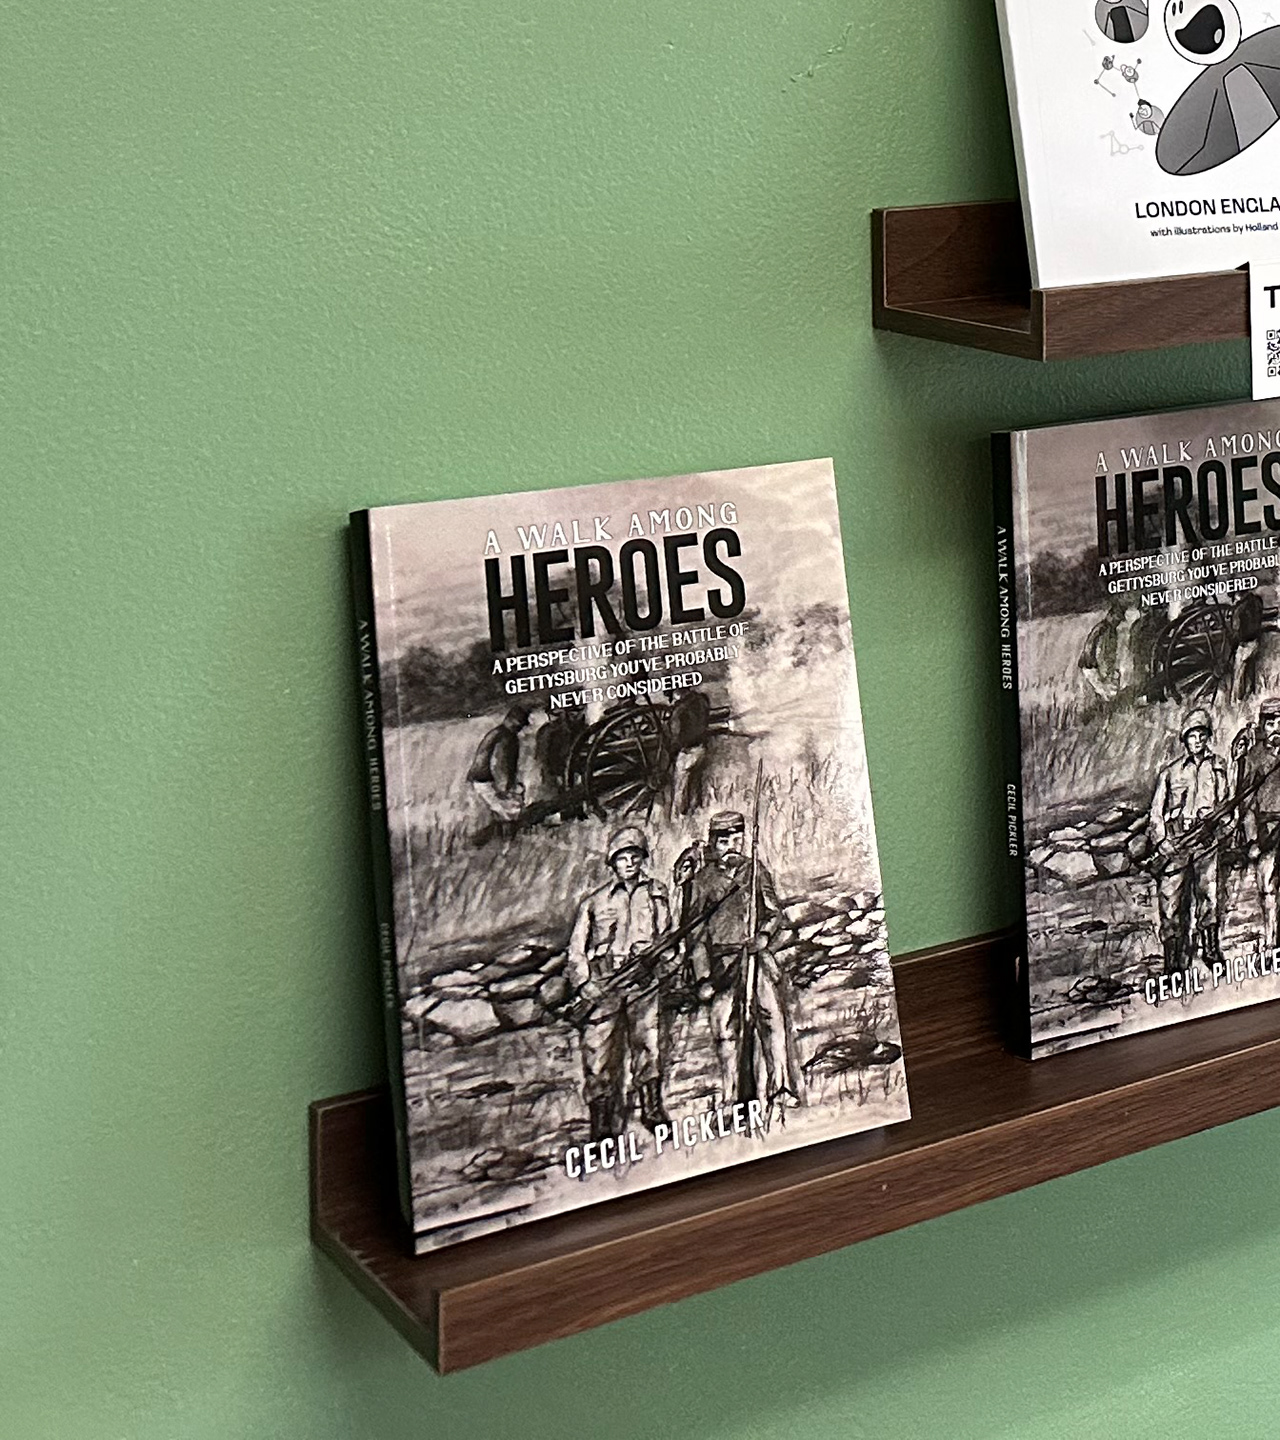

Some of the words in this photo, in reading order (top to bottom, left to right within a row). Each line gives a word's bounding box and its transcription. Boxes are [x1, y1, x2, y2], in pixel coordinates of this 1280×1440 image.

[1135, 198, 1217, 219] LONDON
[1150, 226, 1173, 237] with
[1174, 224, 1231, 236] illustrations
[1232, 223, 1244, 235] by
[1245, 221, 1279, 232] Holland
[1094, 451, 1109, 474] A
[1121, 440, 1192, 469] WALK
[484, 529, 502, 556] A
[517, 516, 613, 551] WALK
[628, 501, 739, 538] AMONG
[997, 525, 1006, 535] A
[997, 538, 1008, 583] WALK
[1099, 563, 1107, 577] A
[1108, 550, 1190, 576] PERSPECTIVE
[1191, 547, 1209, 562] OF
[1209, 543, 1233, 558] THE
[1235, 536, 1277, 554] BATTLE
[484, 527, 747, 654] HEROES
[1107, 569, 1186, 595] GETTYSBURG
[1187, 562, 1228, 580] YOU'VE
[1141, 589, 1183, 608] NEVER
[1184, 576, 1259, 600] CONSIDERED
[999, 586, 1011, 640] AMONG
[491, 658, 504, 675] A
[506, 640, 613, 673] PERSPECTIVE
[615, 638, 637, 656] OF
[638, 633, 670, 653] THE
[672, 625, 728, 648] BATTLE
[728, 620, 749, 638] OF
[1001, 643, 1013, 691] HEROES
[504, 665, 608, 695] GETTYSBURG
[609, 655, 663, 677] YOU'VE
[665, 644, 743, 670] PROBABLY
[550, 687, 604, 710] NEVER
[606, 671, 704, 700] CONSIDERED
[1006, 783, 1016, 813] CECIL
[1007, 814, 1018, 858] PICKLER
[1145, 966, 1205, 1006] CECIL
[565, 1131, 644, 1179] CECIL
[653, 1099, 765, 1155] PICKLER
